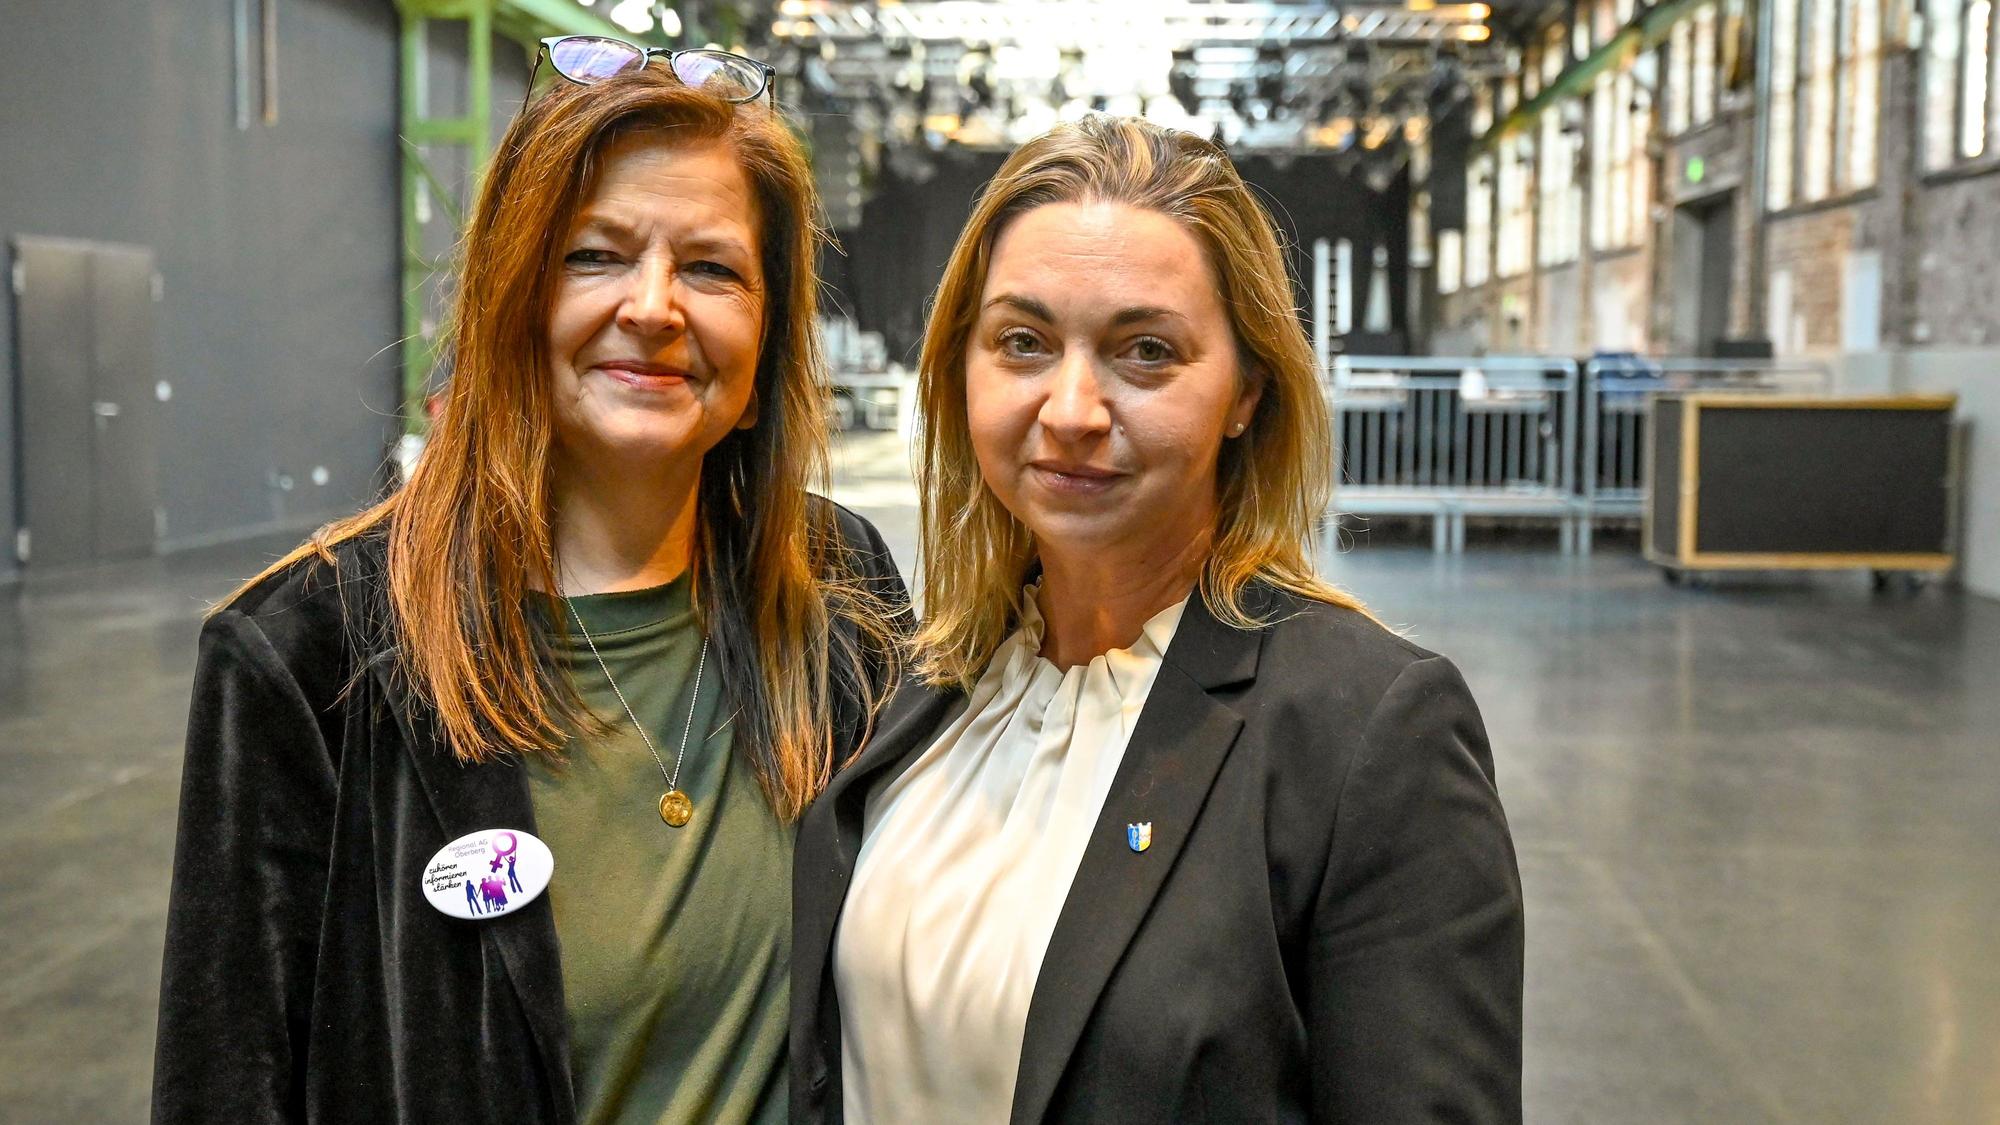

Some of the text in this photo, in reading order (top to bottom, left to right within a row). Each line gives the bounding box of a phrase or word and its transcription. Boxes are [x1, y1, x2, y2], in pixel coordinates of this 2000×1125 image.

[448, 841, 477, 853] Regional
[454, 847, 486, 858] Oberberg
[429, 863, 458, 874] zuhören
[424, 871, 467, 885] informieren
[433, 880, 462, 892] stärken
